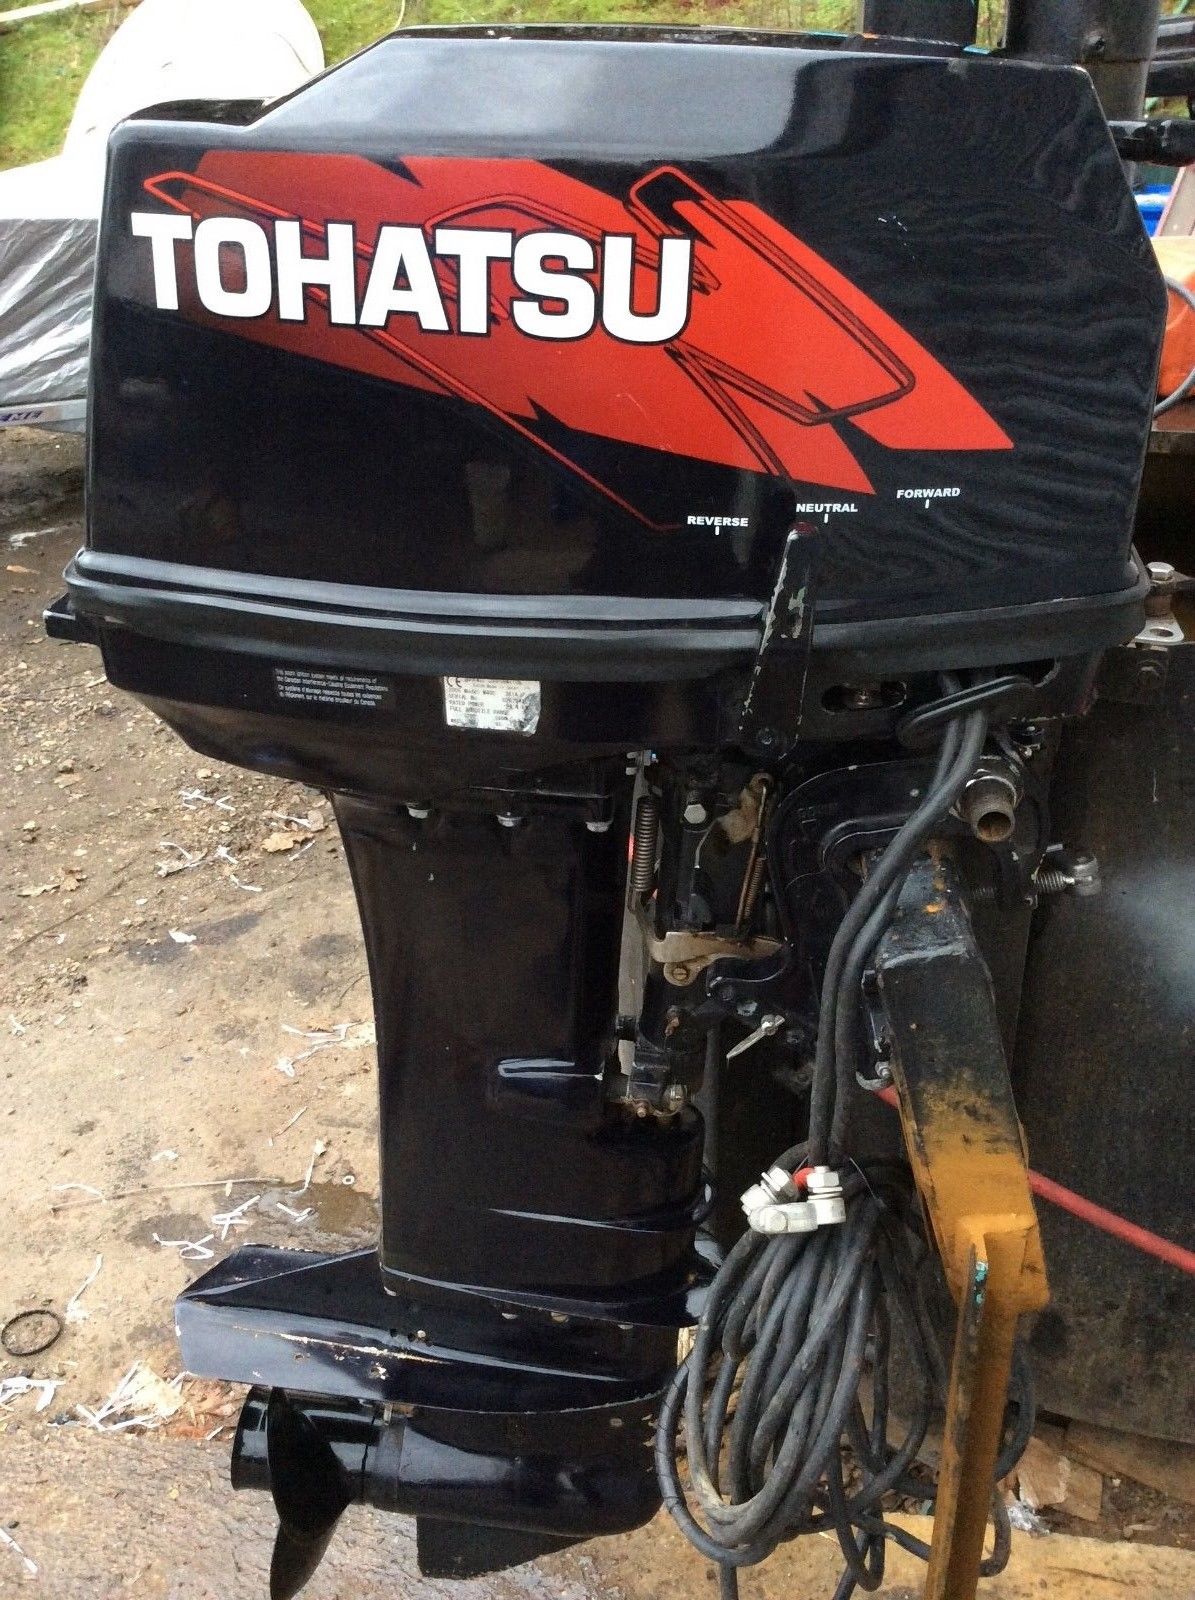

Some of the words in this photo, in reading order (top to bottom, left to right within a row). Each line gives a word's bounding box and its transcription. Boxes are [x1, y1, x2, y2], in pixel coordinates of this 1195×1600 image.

[130, 211, 692, 343] TOHATSU
[896, 487, 962, 499] FORWARD
[795, 503, 859, 514] NEUTRAL
[686, 515, 749, 528] REVERSE
